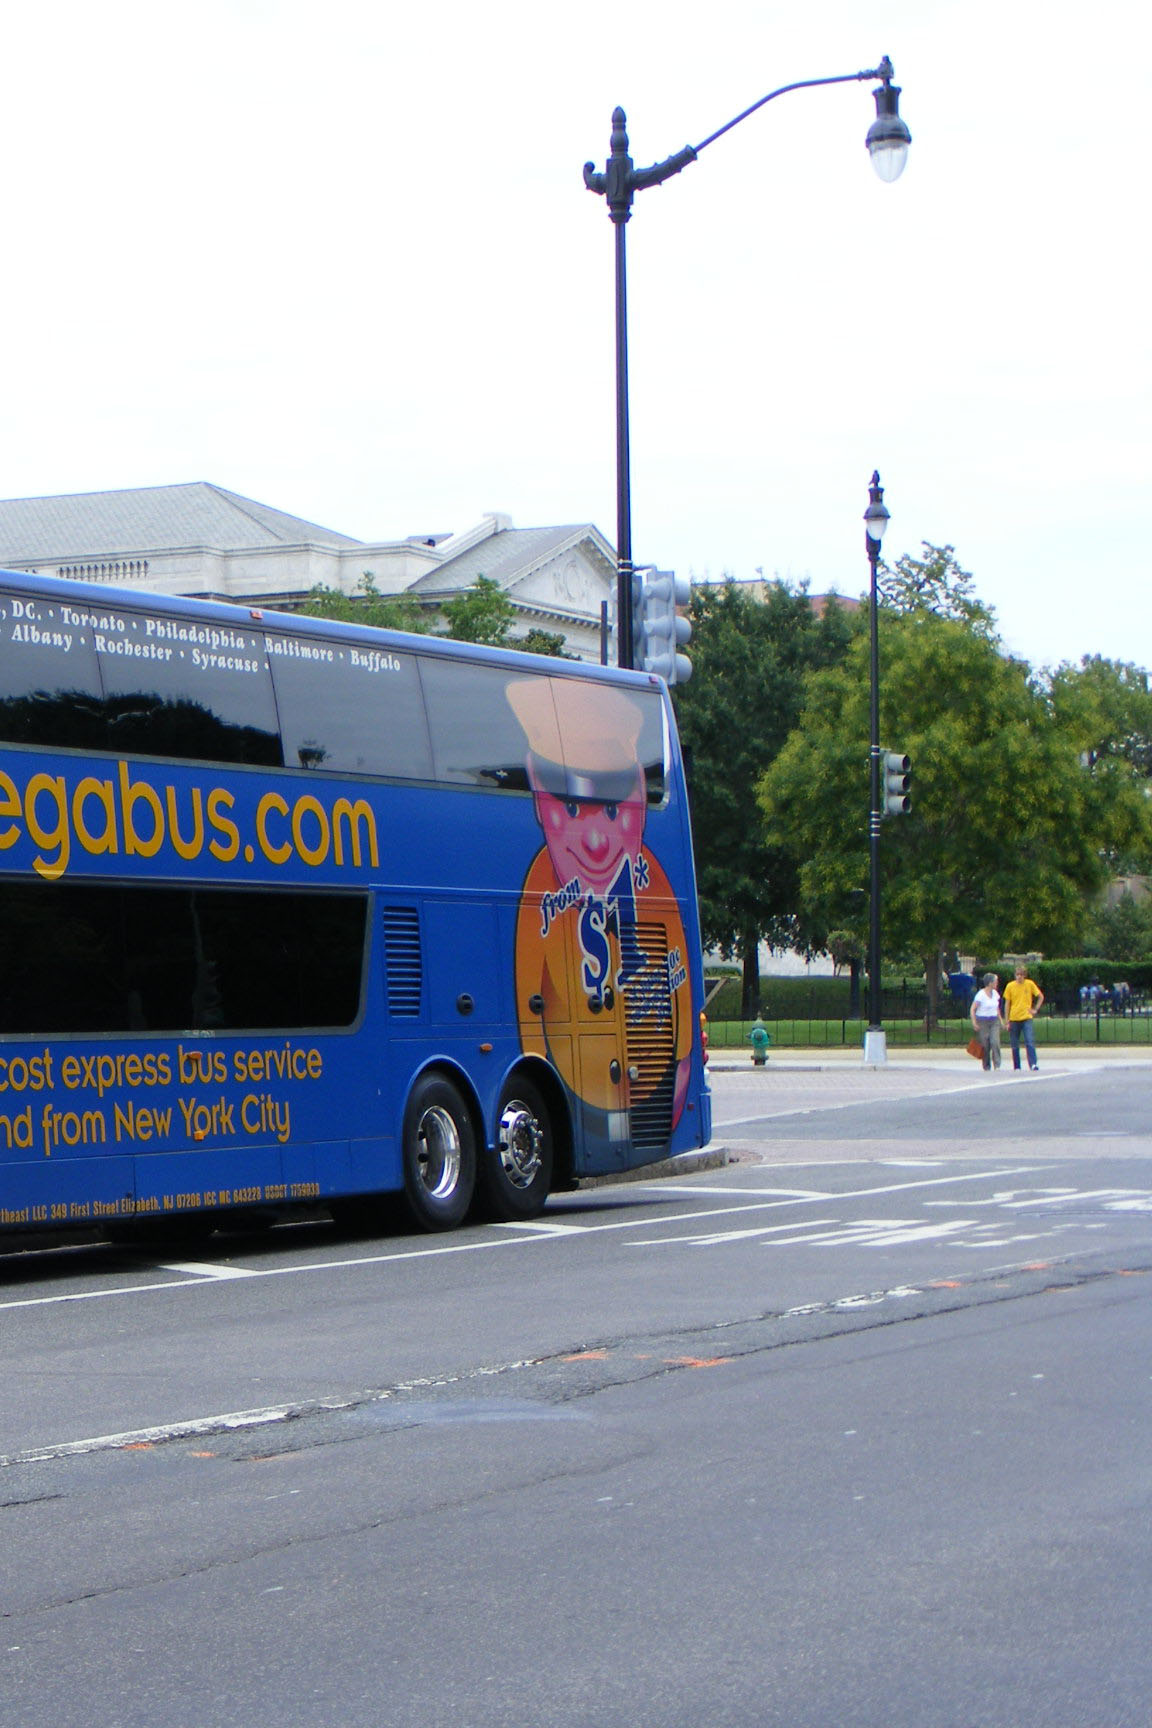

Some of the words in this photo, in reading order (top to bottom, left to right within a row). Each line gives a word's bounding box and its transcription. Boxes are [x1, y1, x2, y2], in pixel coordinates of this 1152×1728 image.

[11, 623, 73, 653] Albany
[95, 634, 173, 661] Rochester
[192, 648, 260, 673] Syracuse
[61, 606, 126, 633] Toronto
[145, 619, 246, 651] Philadelphia
[264, 637, 334, 663] Baltimore
[350, 649, 401, 672] Buffalo
[541, 877, 581, 937] from
[61, 1051, 172, 1098] express
[178, 1044, 228, 1085] bus
[234, 1041, 323, 1082] service
[41, 1103, 106, 1156] from
[114, 1100, 173, 1142] New
[178, 1096, 236, 1139] York
[241, 1093, 291, 1144] City
[32, 1204, 48, 1221] LLC
[50, 1203, 67, 1219] 349
[70, 1202, 90, 1217] First
[93, 1199, 119, 1215] Street
[163, 1195, 174, 1210] NJ
